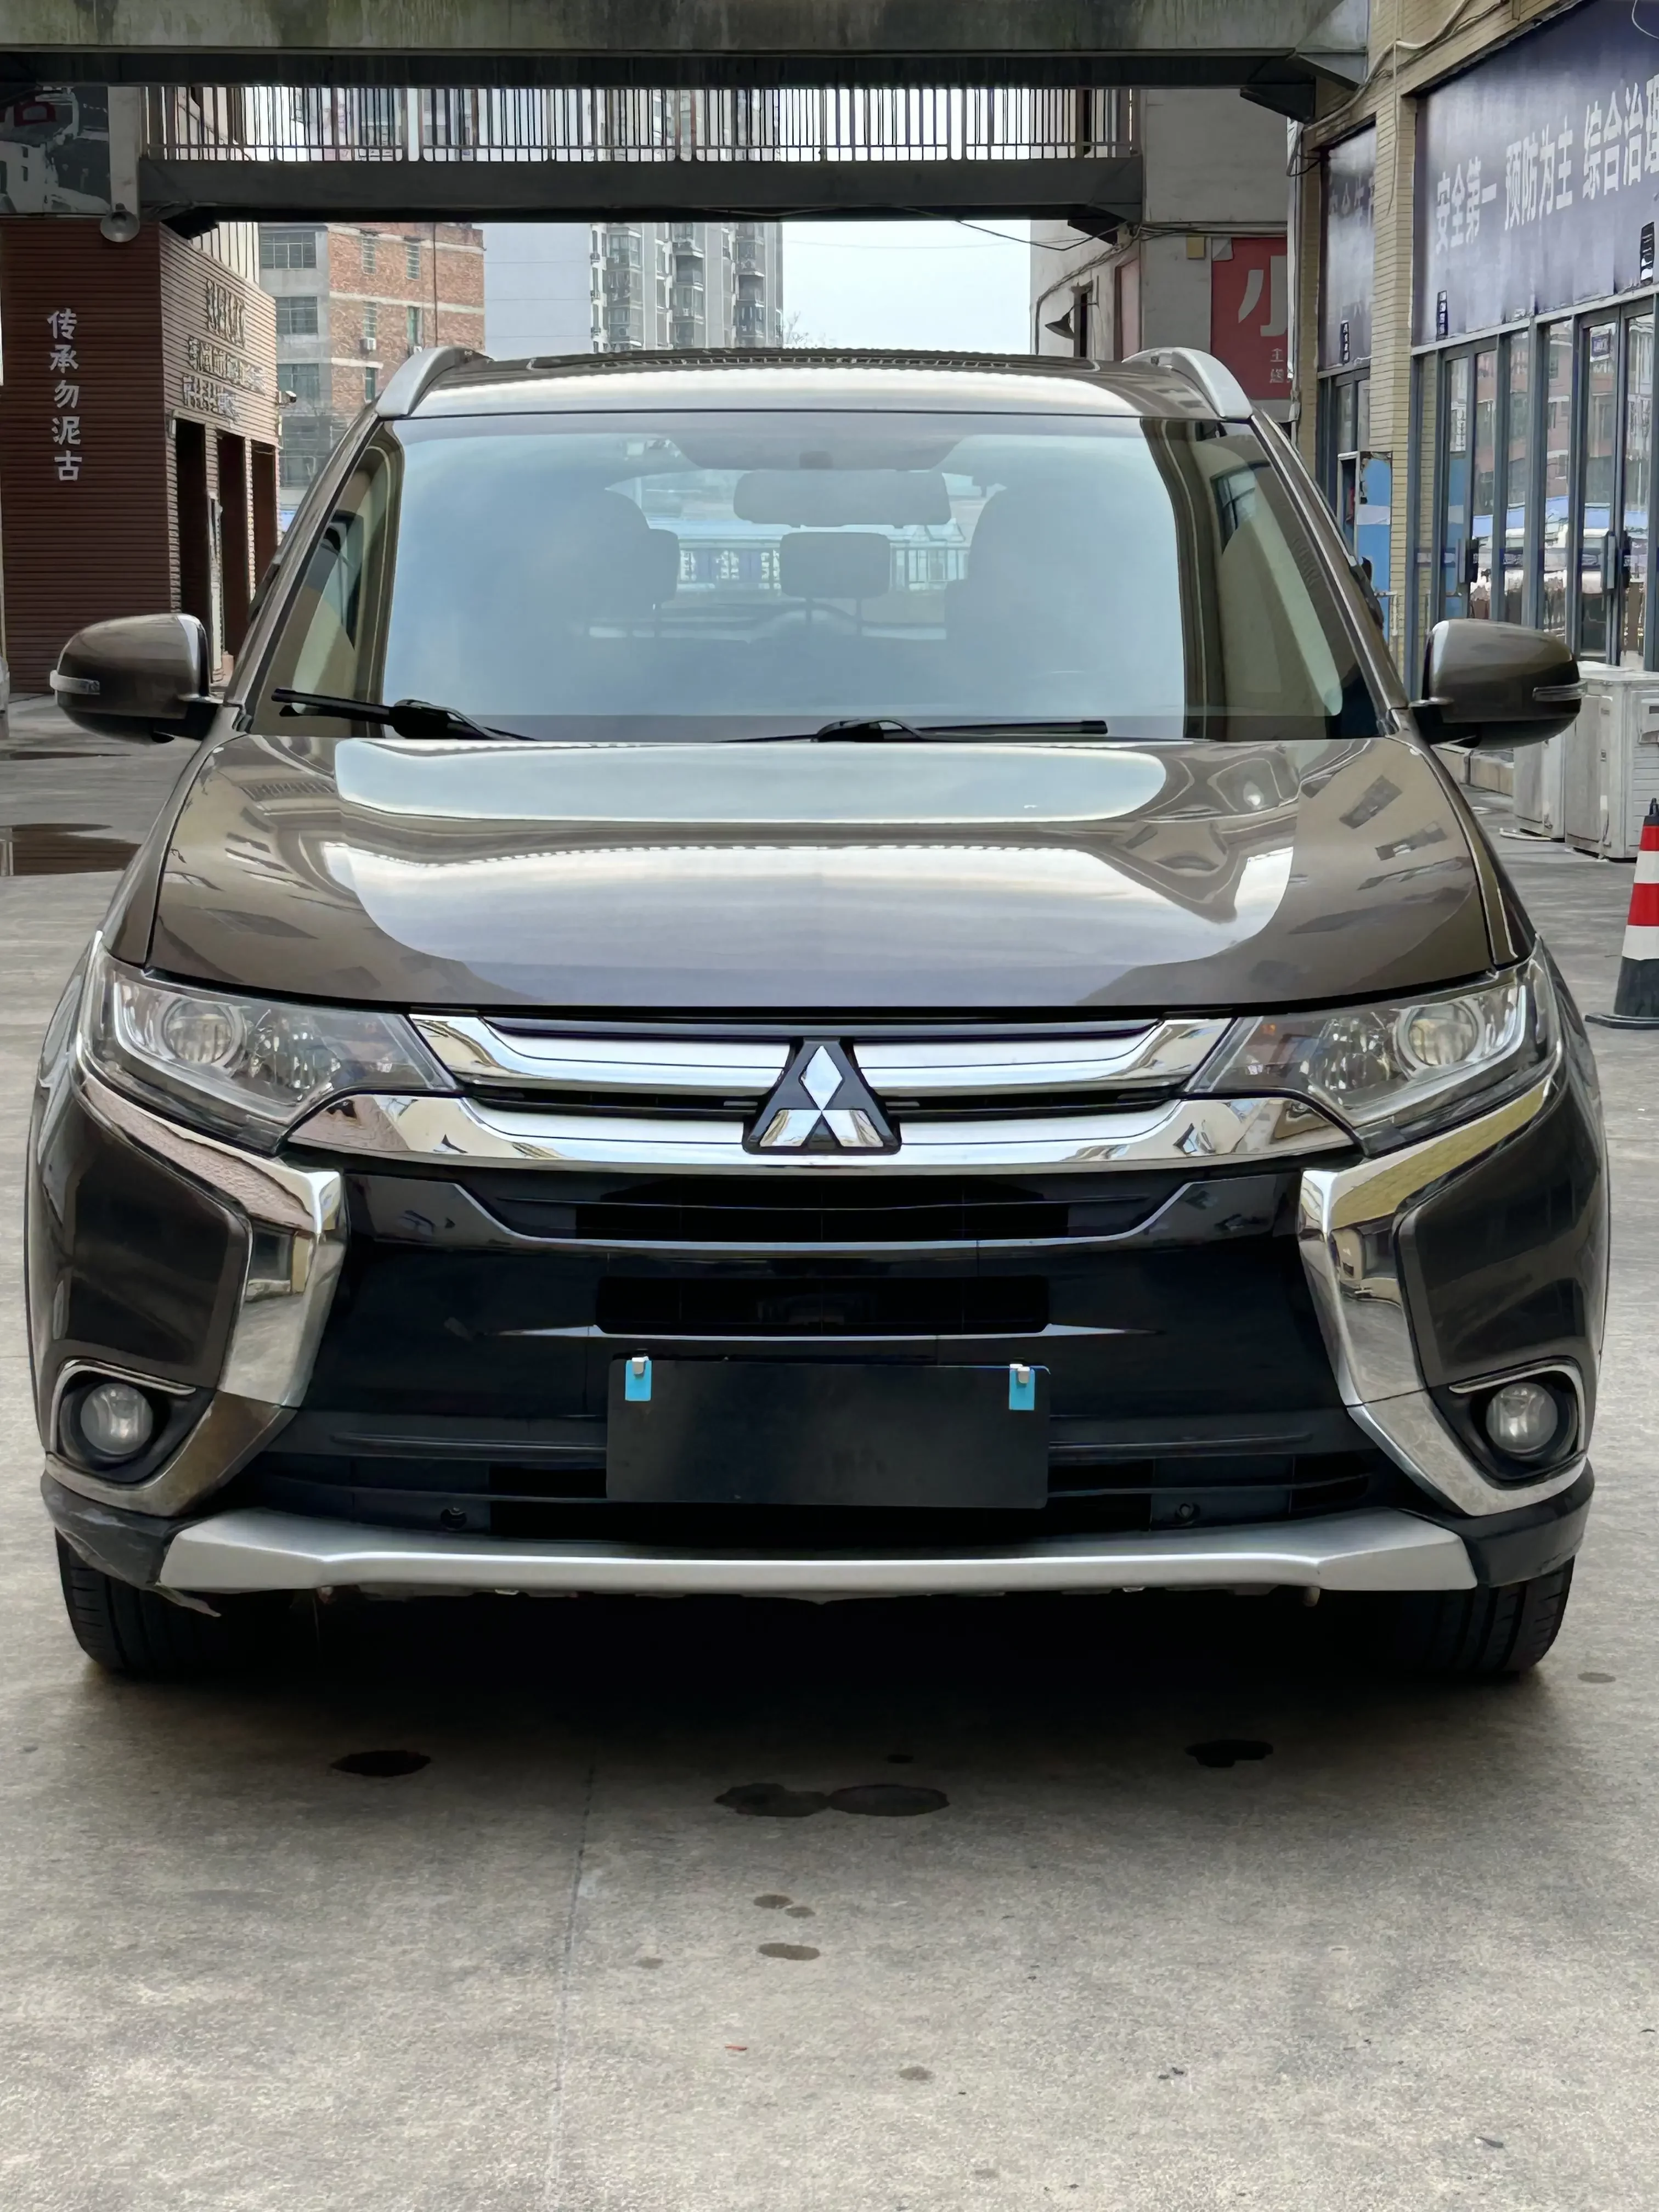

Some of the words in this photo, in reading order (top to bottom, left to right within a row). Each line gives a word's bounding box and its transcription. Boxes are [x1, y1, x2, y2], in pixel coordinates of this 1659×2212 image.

[1436, 156, 1497, 255] 安全第一
[1505, 115, 1573, 231] 预防为主
[47, 308, 82, 481] 传承勿泥古
